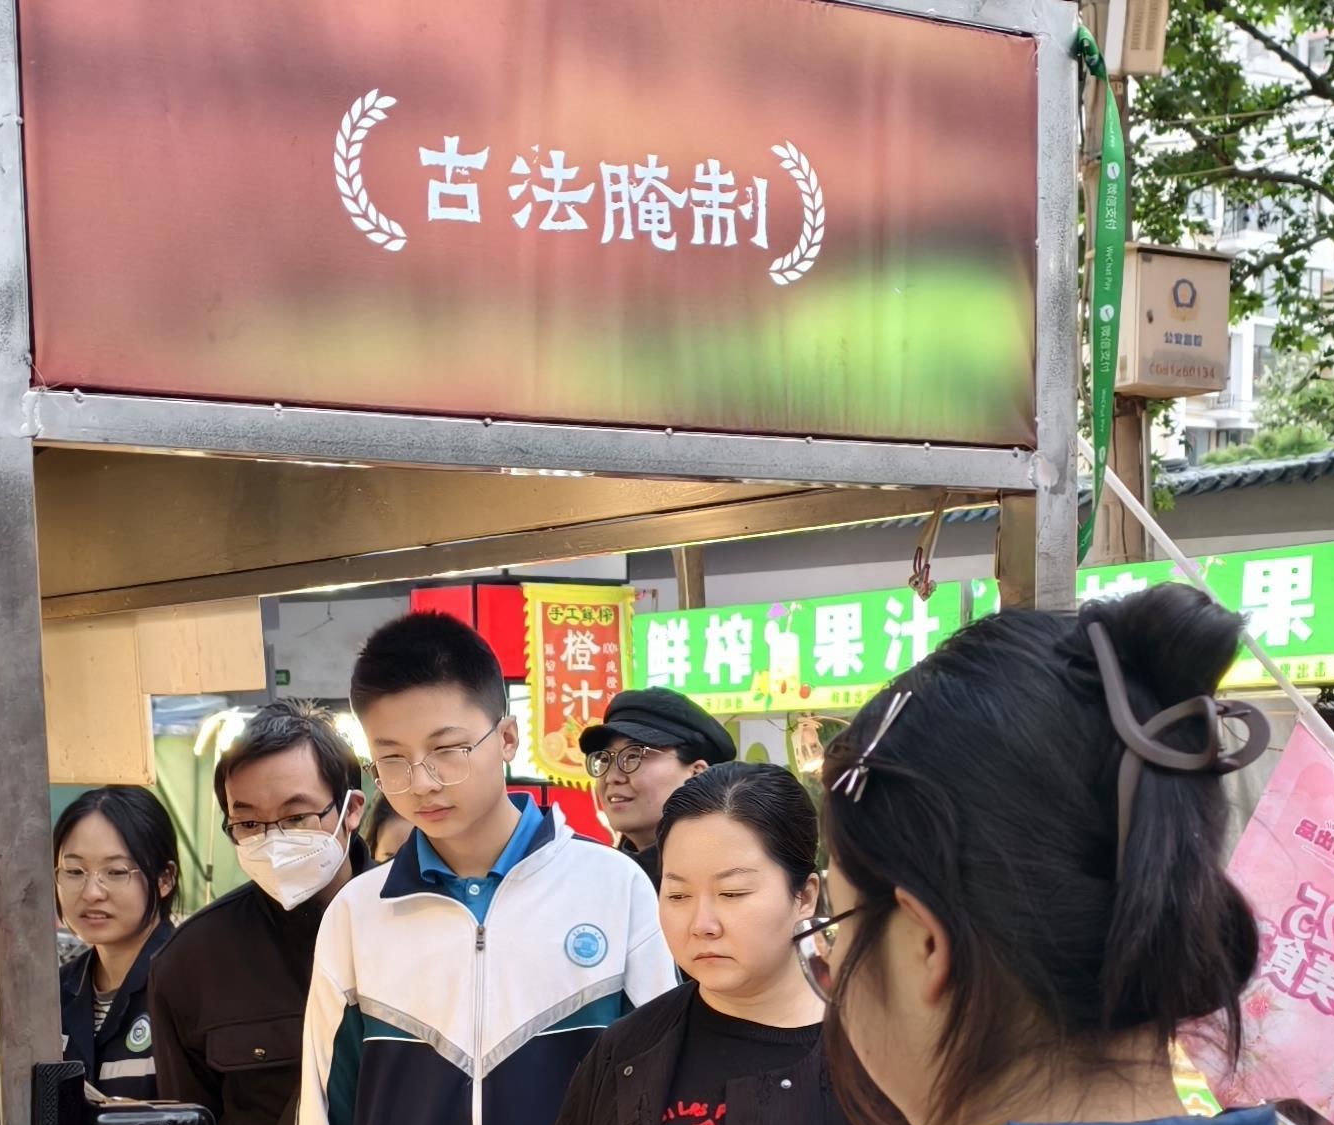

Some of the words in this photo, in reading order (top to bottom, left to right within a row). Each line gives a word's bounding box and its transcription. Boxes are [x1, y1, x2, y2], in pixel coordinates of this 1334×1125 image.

[418, 135, 769, 252] 古法腌制
[1104, 182, 1117, 230] 微信支付
[1104, 245, 1114, 275] WeChat
[560, 628, 604, 722] 橙汁
[814, 593, 940, 677] 果汁
